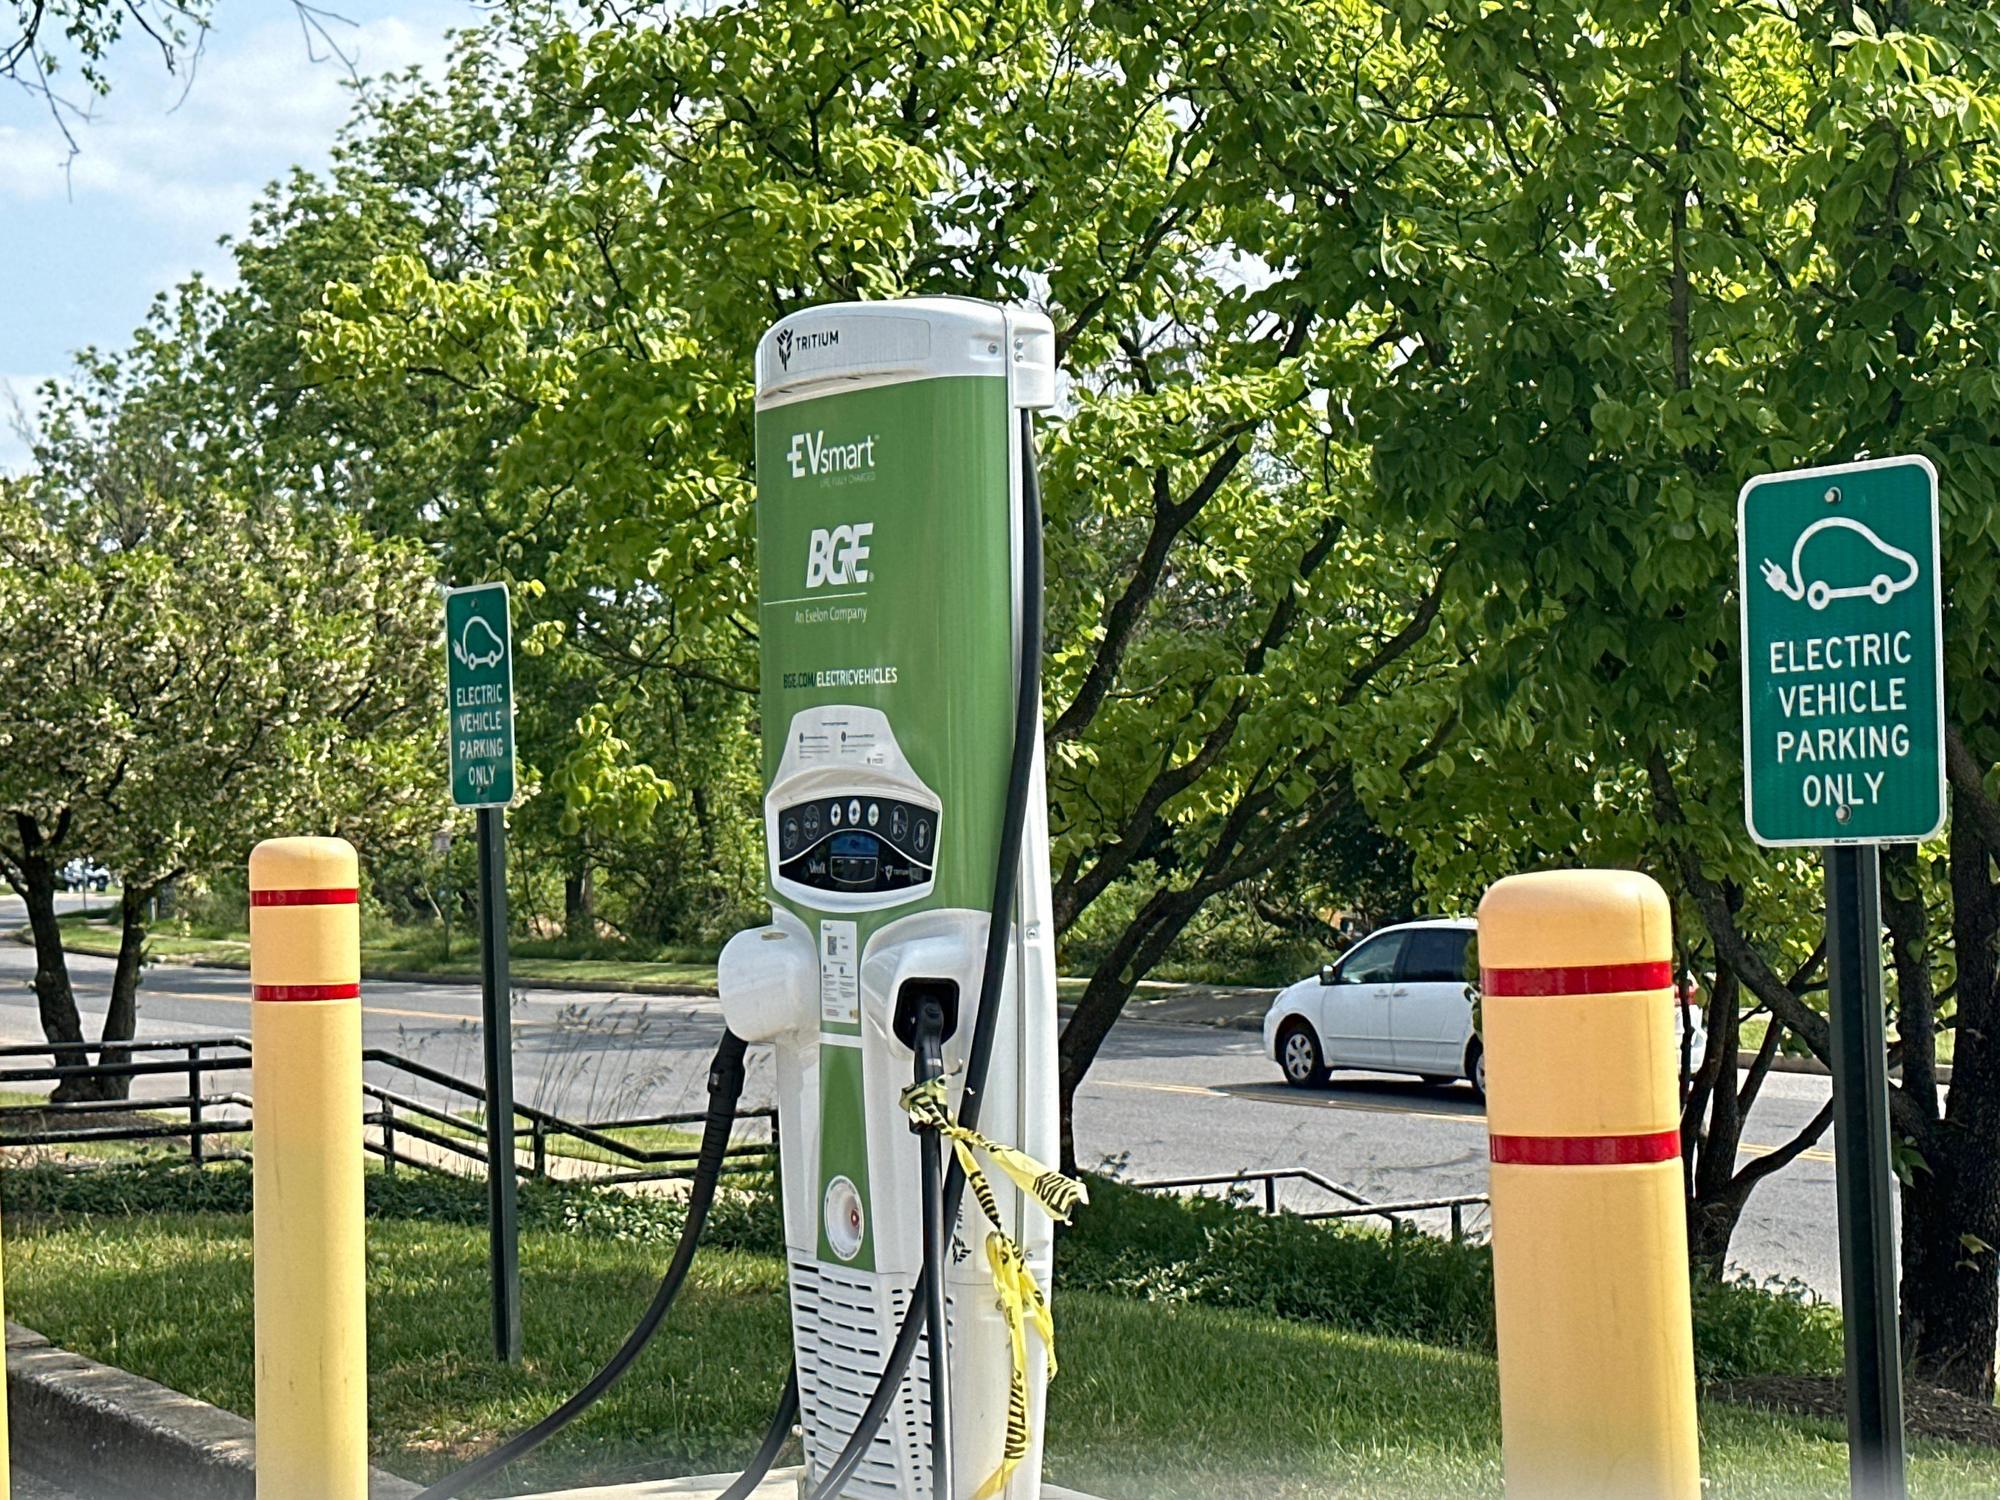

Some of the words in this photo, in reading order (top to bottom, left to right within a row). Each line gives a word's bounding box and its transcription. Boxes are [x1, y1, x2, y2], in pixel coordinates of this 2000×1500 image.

[796, 330, 839, 351] TRITIUM
[806, 522, 874, 588] BGE
[795, 610, 805, 624] An
[805, 607, 829, 624] Exelon
[830, 606, 868, 624] Company
[1770, 631, 1912, 674] ELECTRIC
[456, 683, 503, 707] ELECTRIC
[1778, 678, 1907, 717] VEHICLE
[459, 711, 503, 732] VEHICLE
[459, 737, 504, 760] PARKING
[1776, 724, 1910, 763] PARKING
[468, 765, 496, 786] ONLY
[1802, 771, 1885, 808] ONLY
